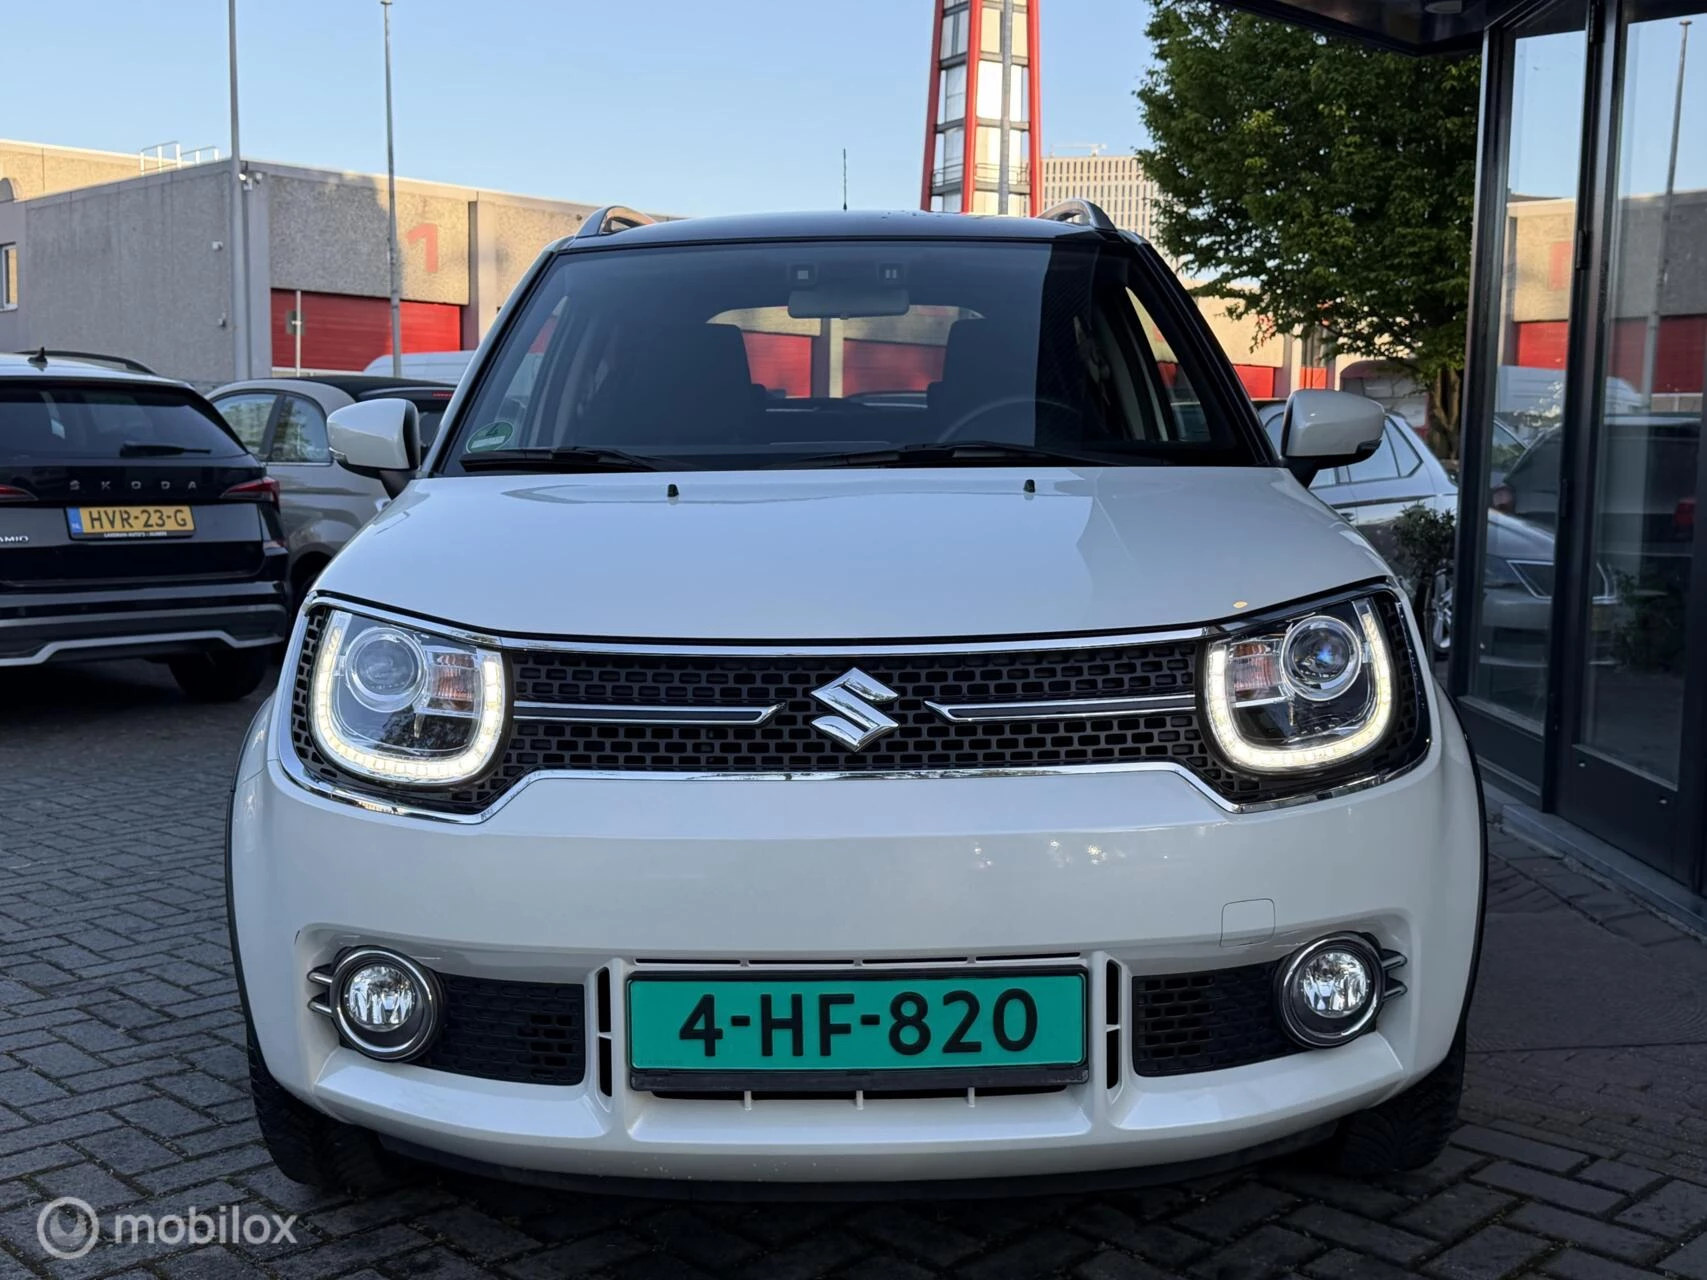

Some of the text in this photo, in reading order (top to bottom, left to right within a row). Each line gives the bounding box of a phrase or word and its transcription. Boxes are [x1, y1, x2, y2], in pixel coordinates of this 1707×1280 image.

[406, 223, 438, 273] 1
[88, 508, 188, 529] HVR-23-G
[678, 987, 1039, 1057] 4-HF-820
